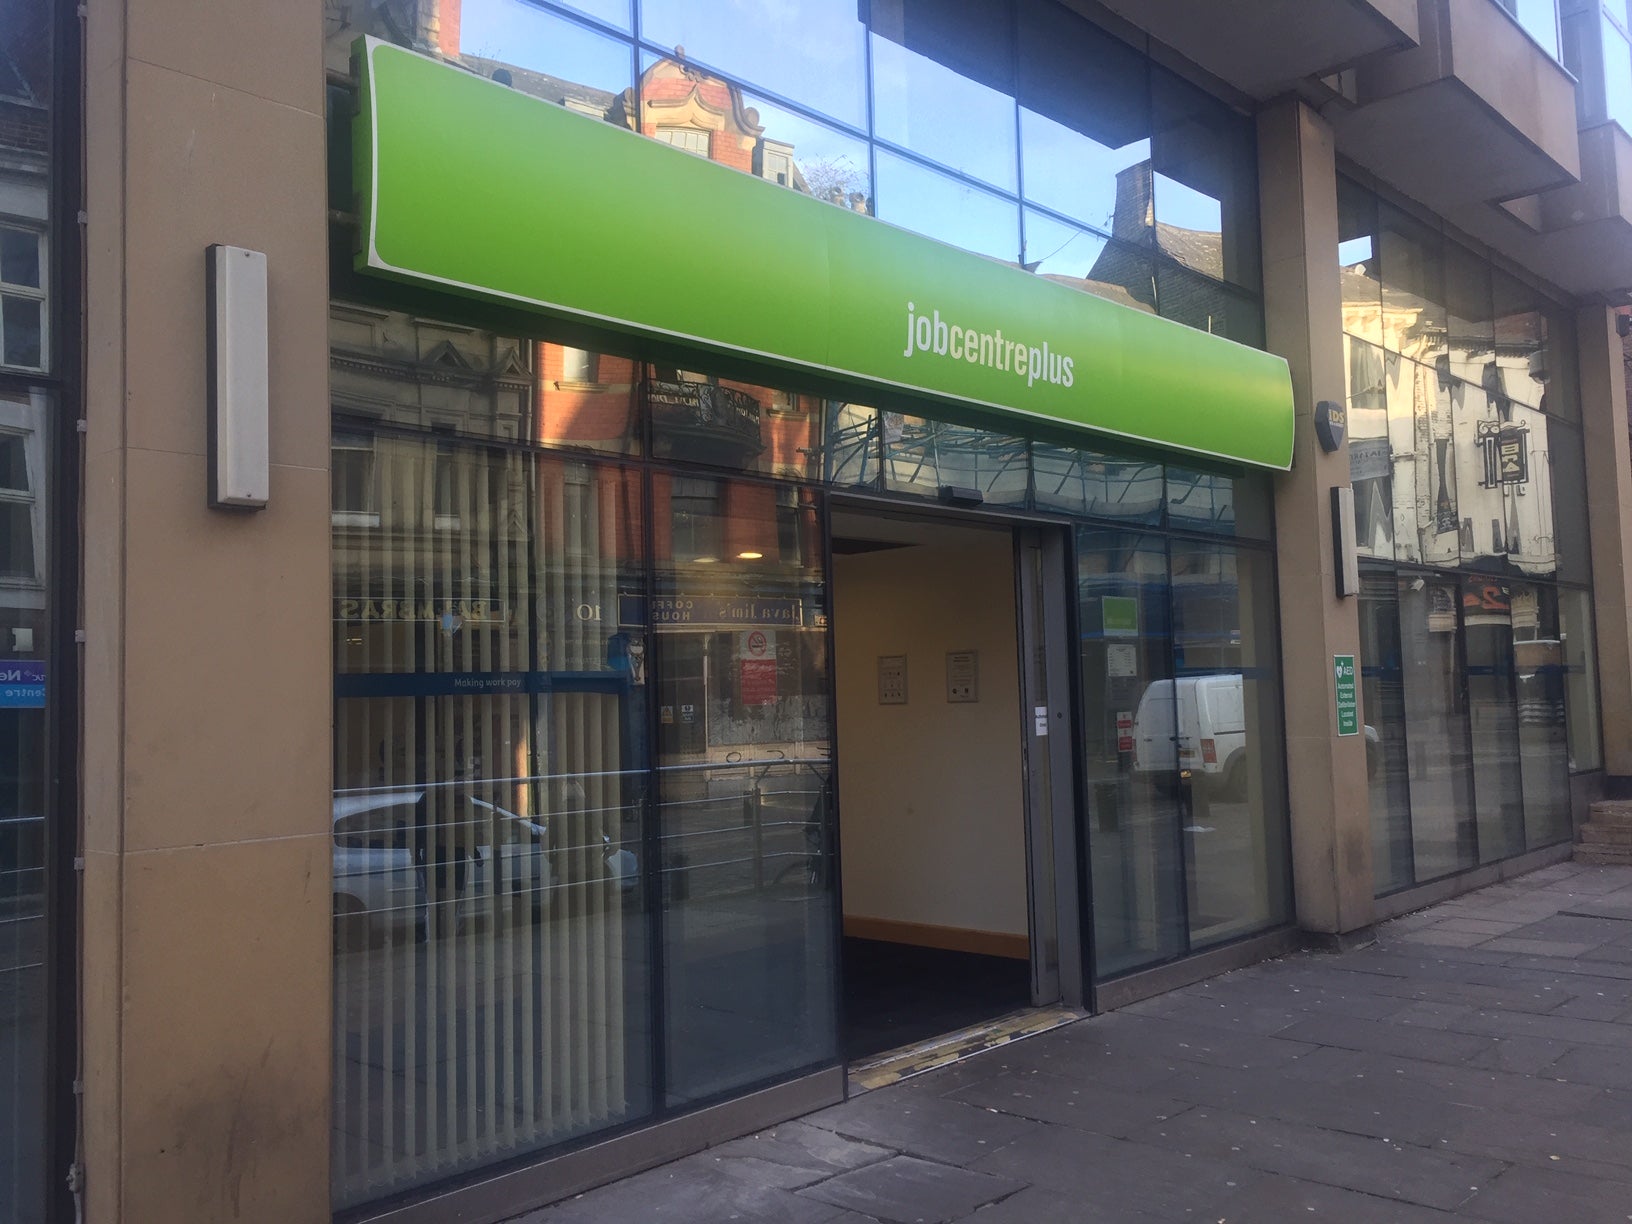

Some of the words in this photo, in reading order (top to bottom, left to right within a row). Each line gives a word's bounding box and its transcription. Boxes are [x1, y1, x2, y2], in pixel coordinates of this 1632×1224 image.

[903, 301, 1074, 388] jobcentreplus
[1343, 666, 1353, 676] AED
[454, 676, 484, 689] Making
[485, 677, 506, 687] work
[506, 678, 522, 688] pay
